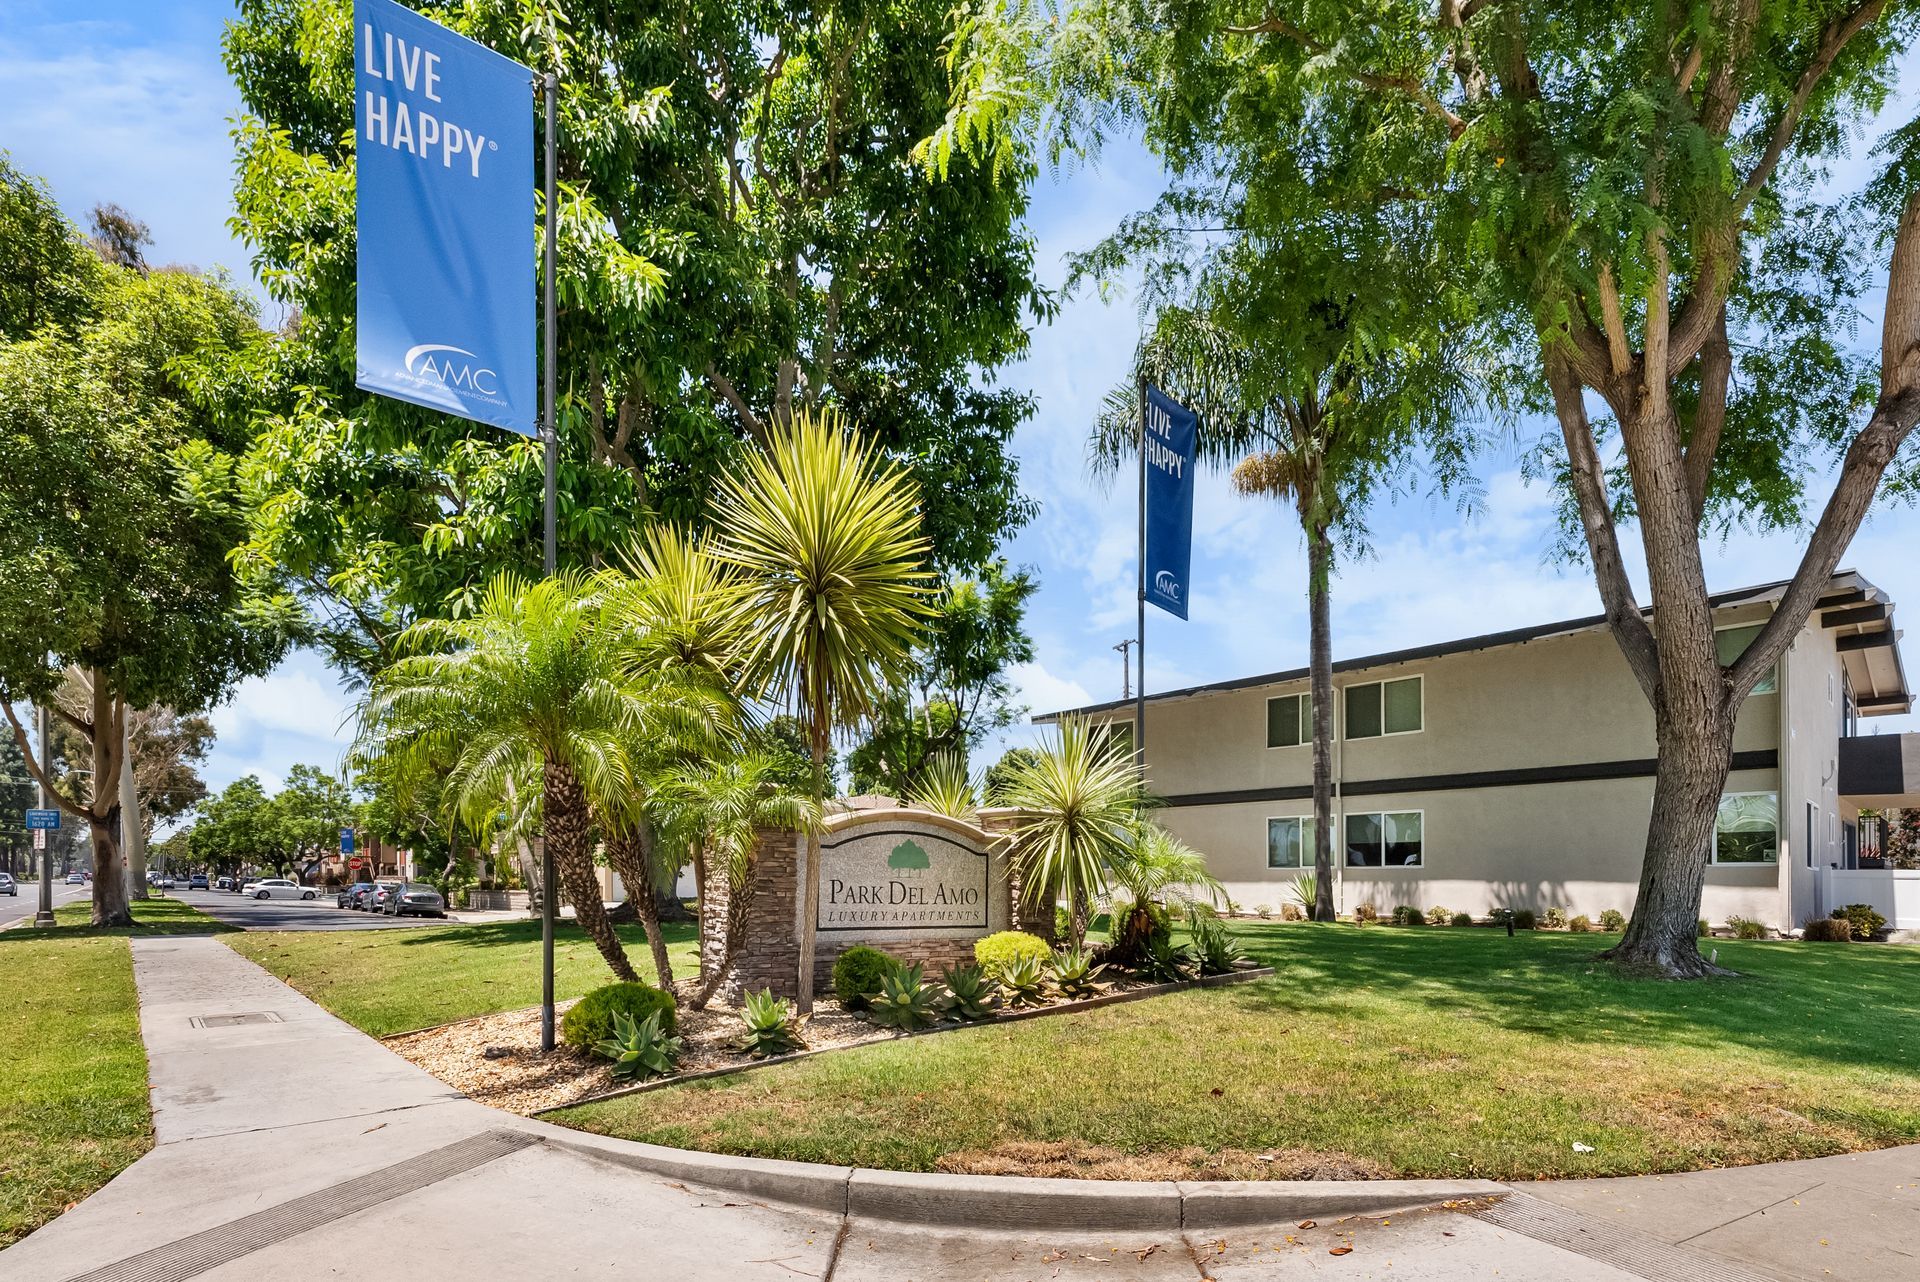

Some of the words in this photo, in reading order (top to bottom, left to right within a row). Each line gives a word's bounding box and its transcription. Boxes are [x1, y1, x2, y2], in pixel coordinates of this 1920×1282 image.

[364, 23, 442, 104] LIVE
[419, 355, 497, 395] AMC
[1149, 402, 1171, 440] LIVE
[1159, 576, 1180, 599] AMC
[829, 879, 884, 905] PARK
[888, 881, 929, 905] DEL
[932, 883, 978, 905] AMO
[828, 911, 889, 922] LUXURY
[891, 910, 980, 921] APARTMENTS
